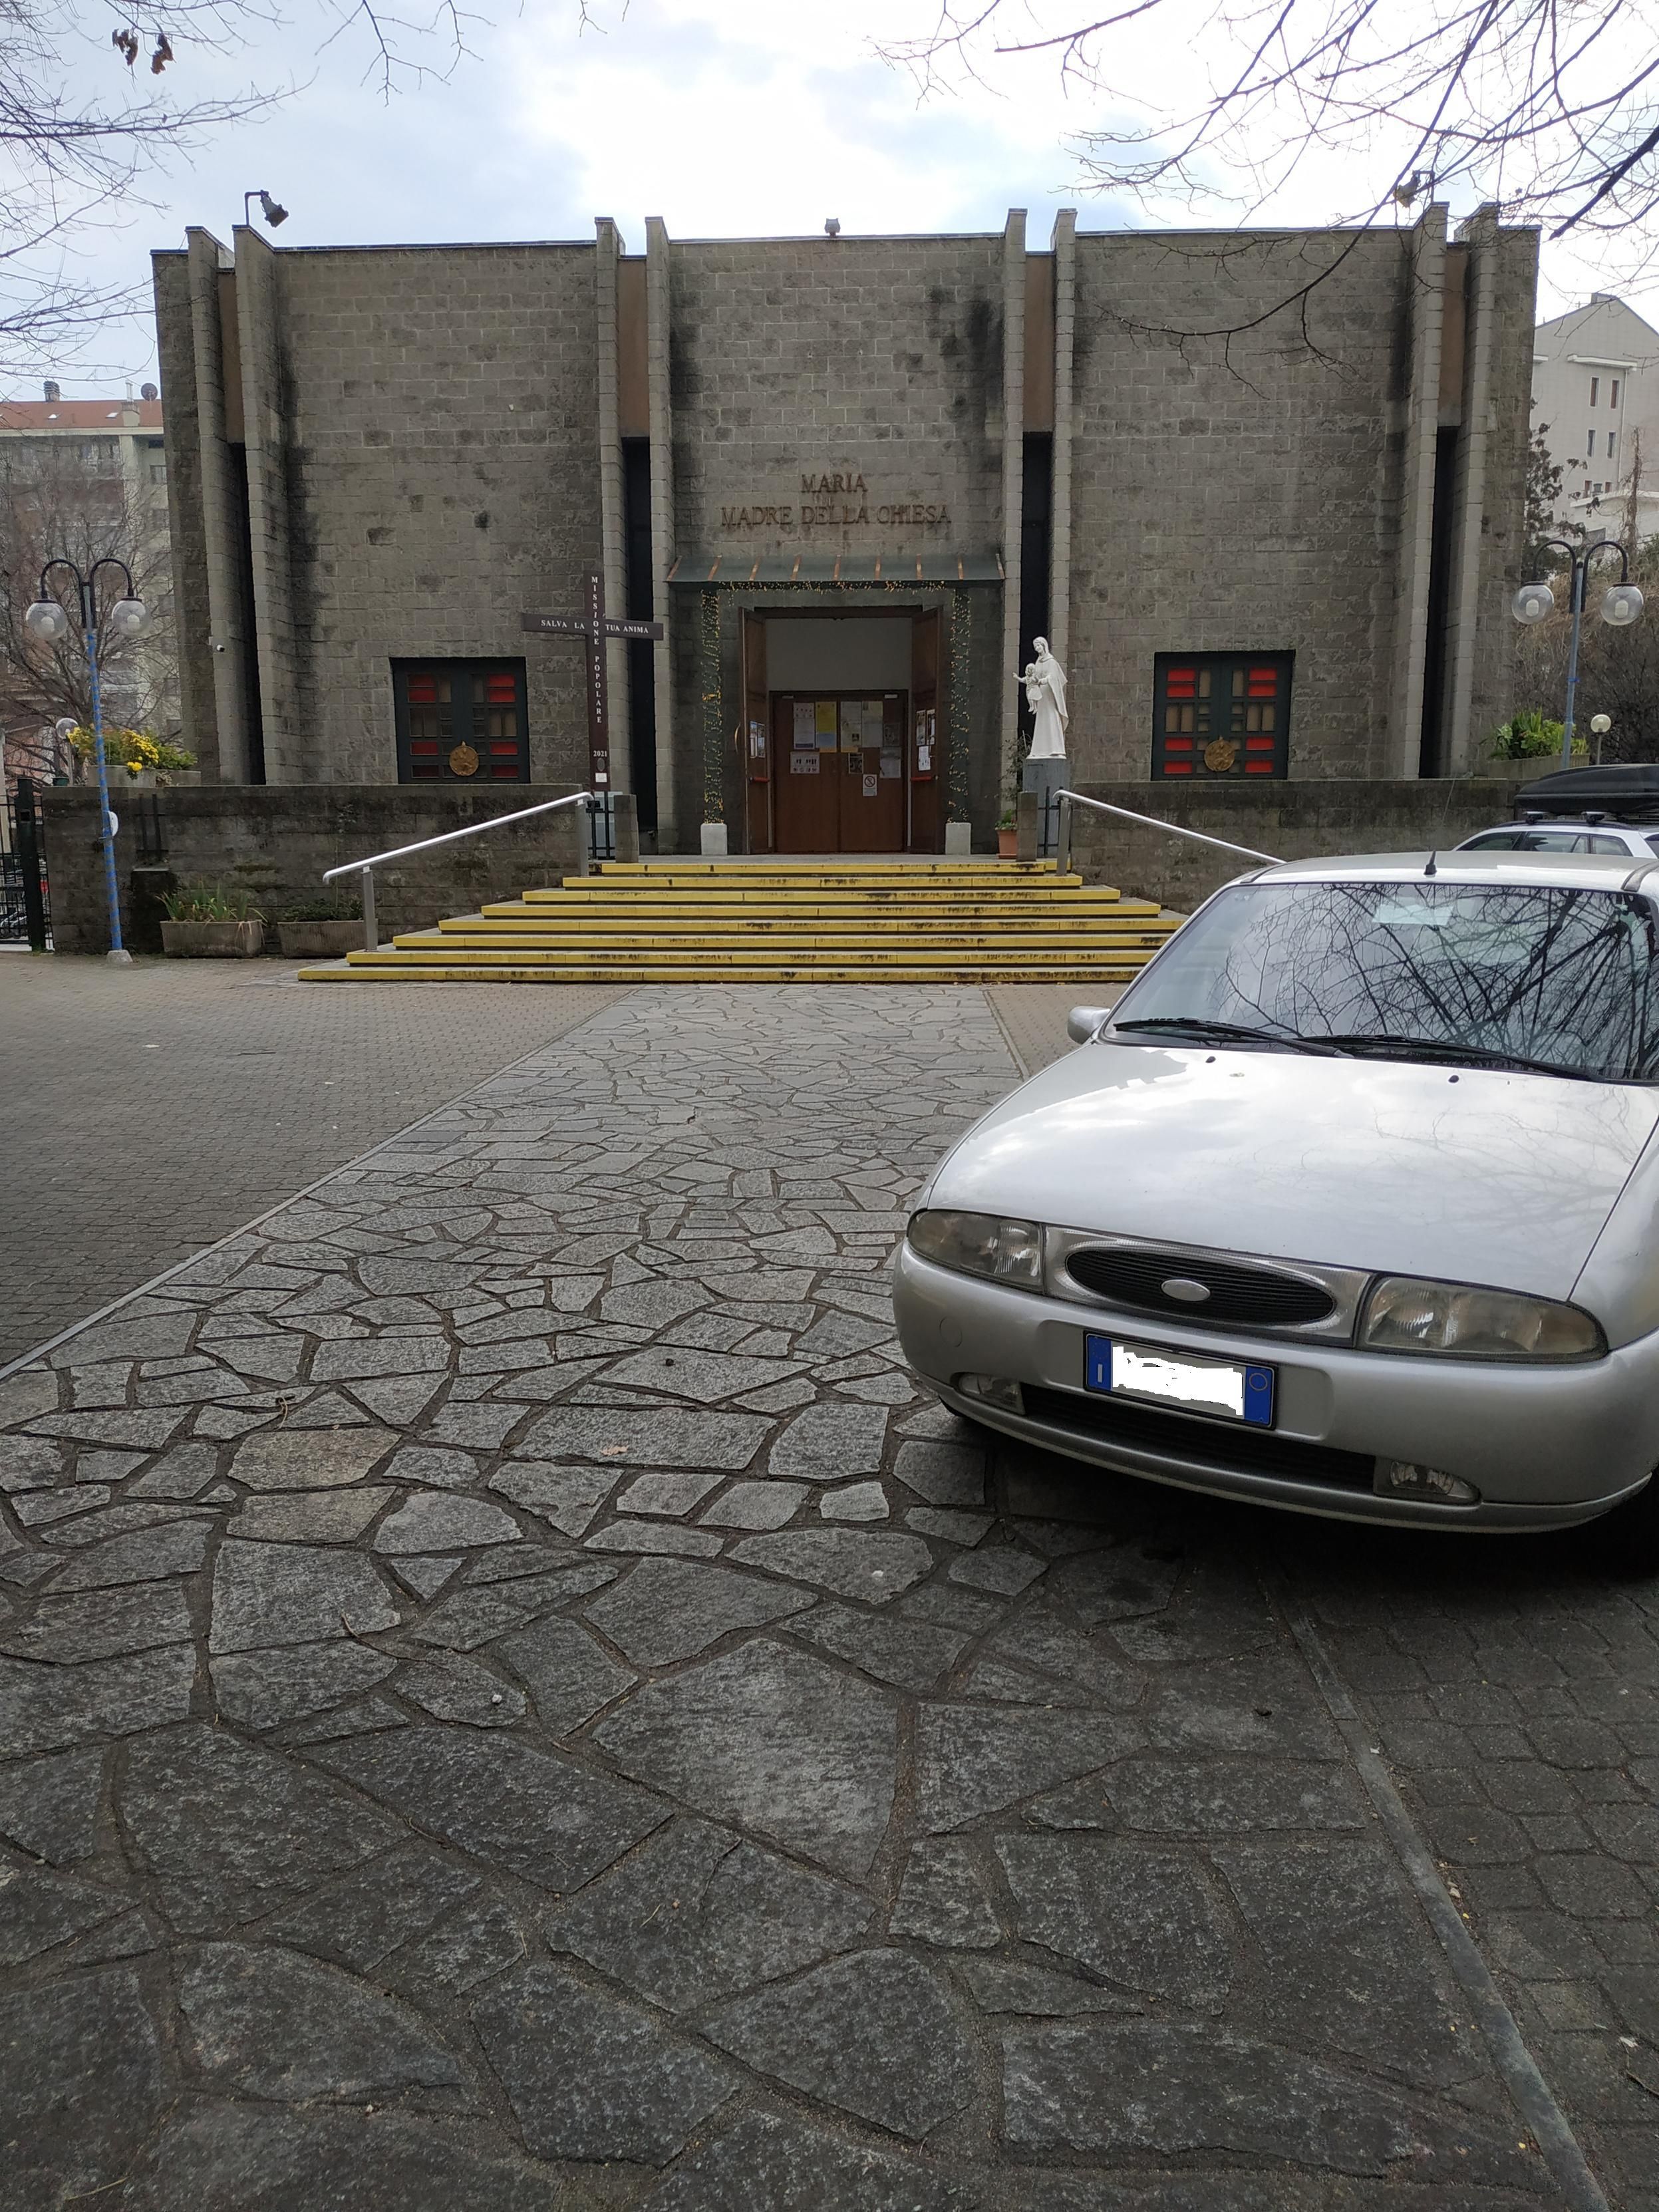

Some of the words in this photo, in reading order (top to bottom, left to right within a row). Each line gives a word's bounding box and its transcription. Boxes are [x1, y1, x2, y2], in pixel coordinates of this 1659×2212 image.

[801, 473, 867, 493] MARIA
[721, 506, 793, 526] MADRE
[801, 506, 871, 525] DELLA
[877, 504, 951, 524] CHIESA
[591, 576, 599, 645] MISSIONE
[541, 619, 567, 628] SALVA
[605, 623, 620, 632] TUA
[623, 625, 649, 634] ANIMA
